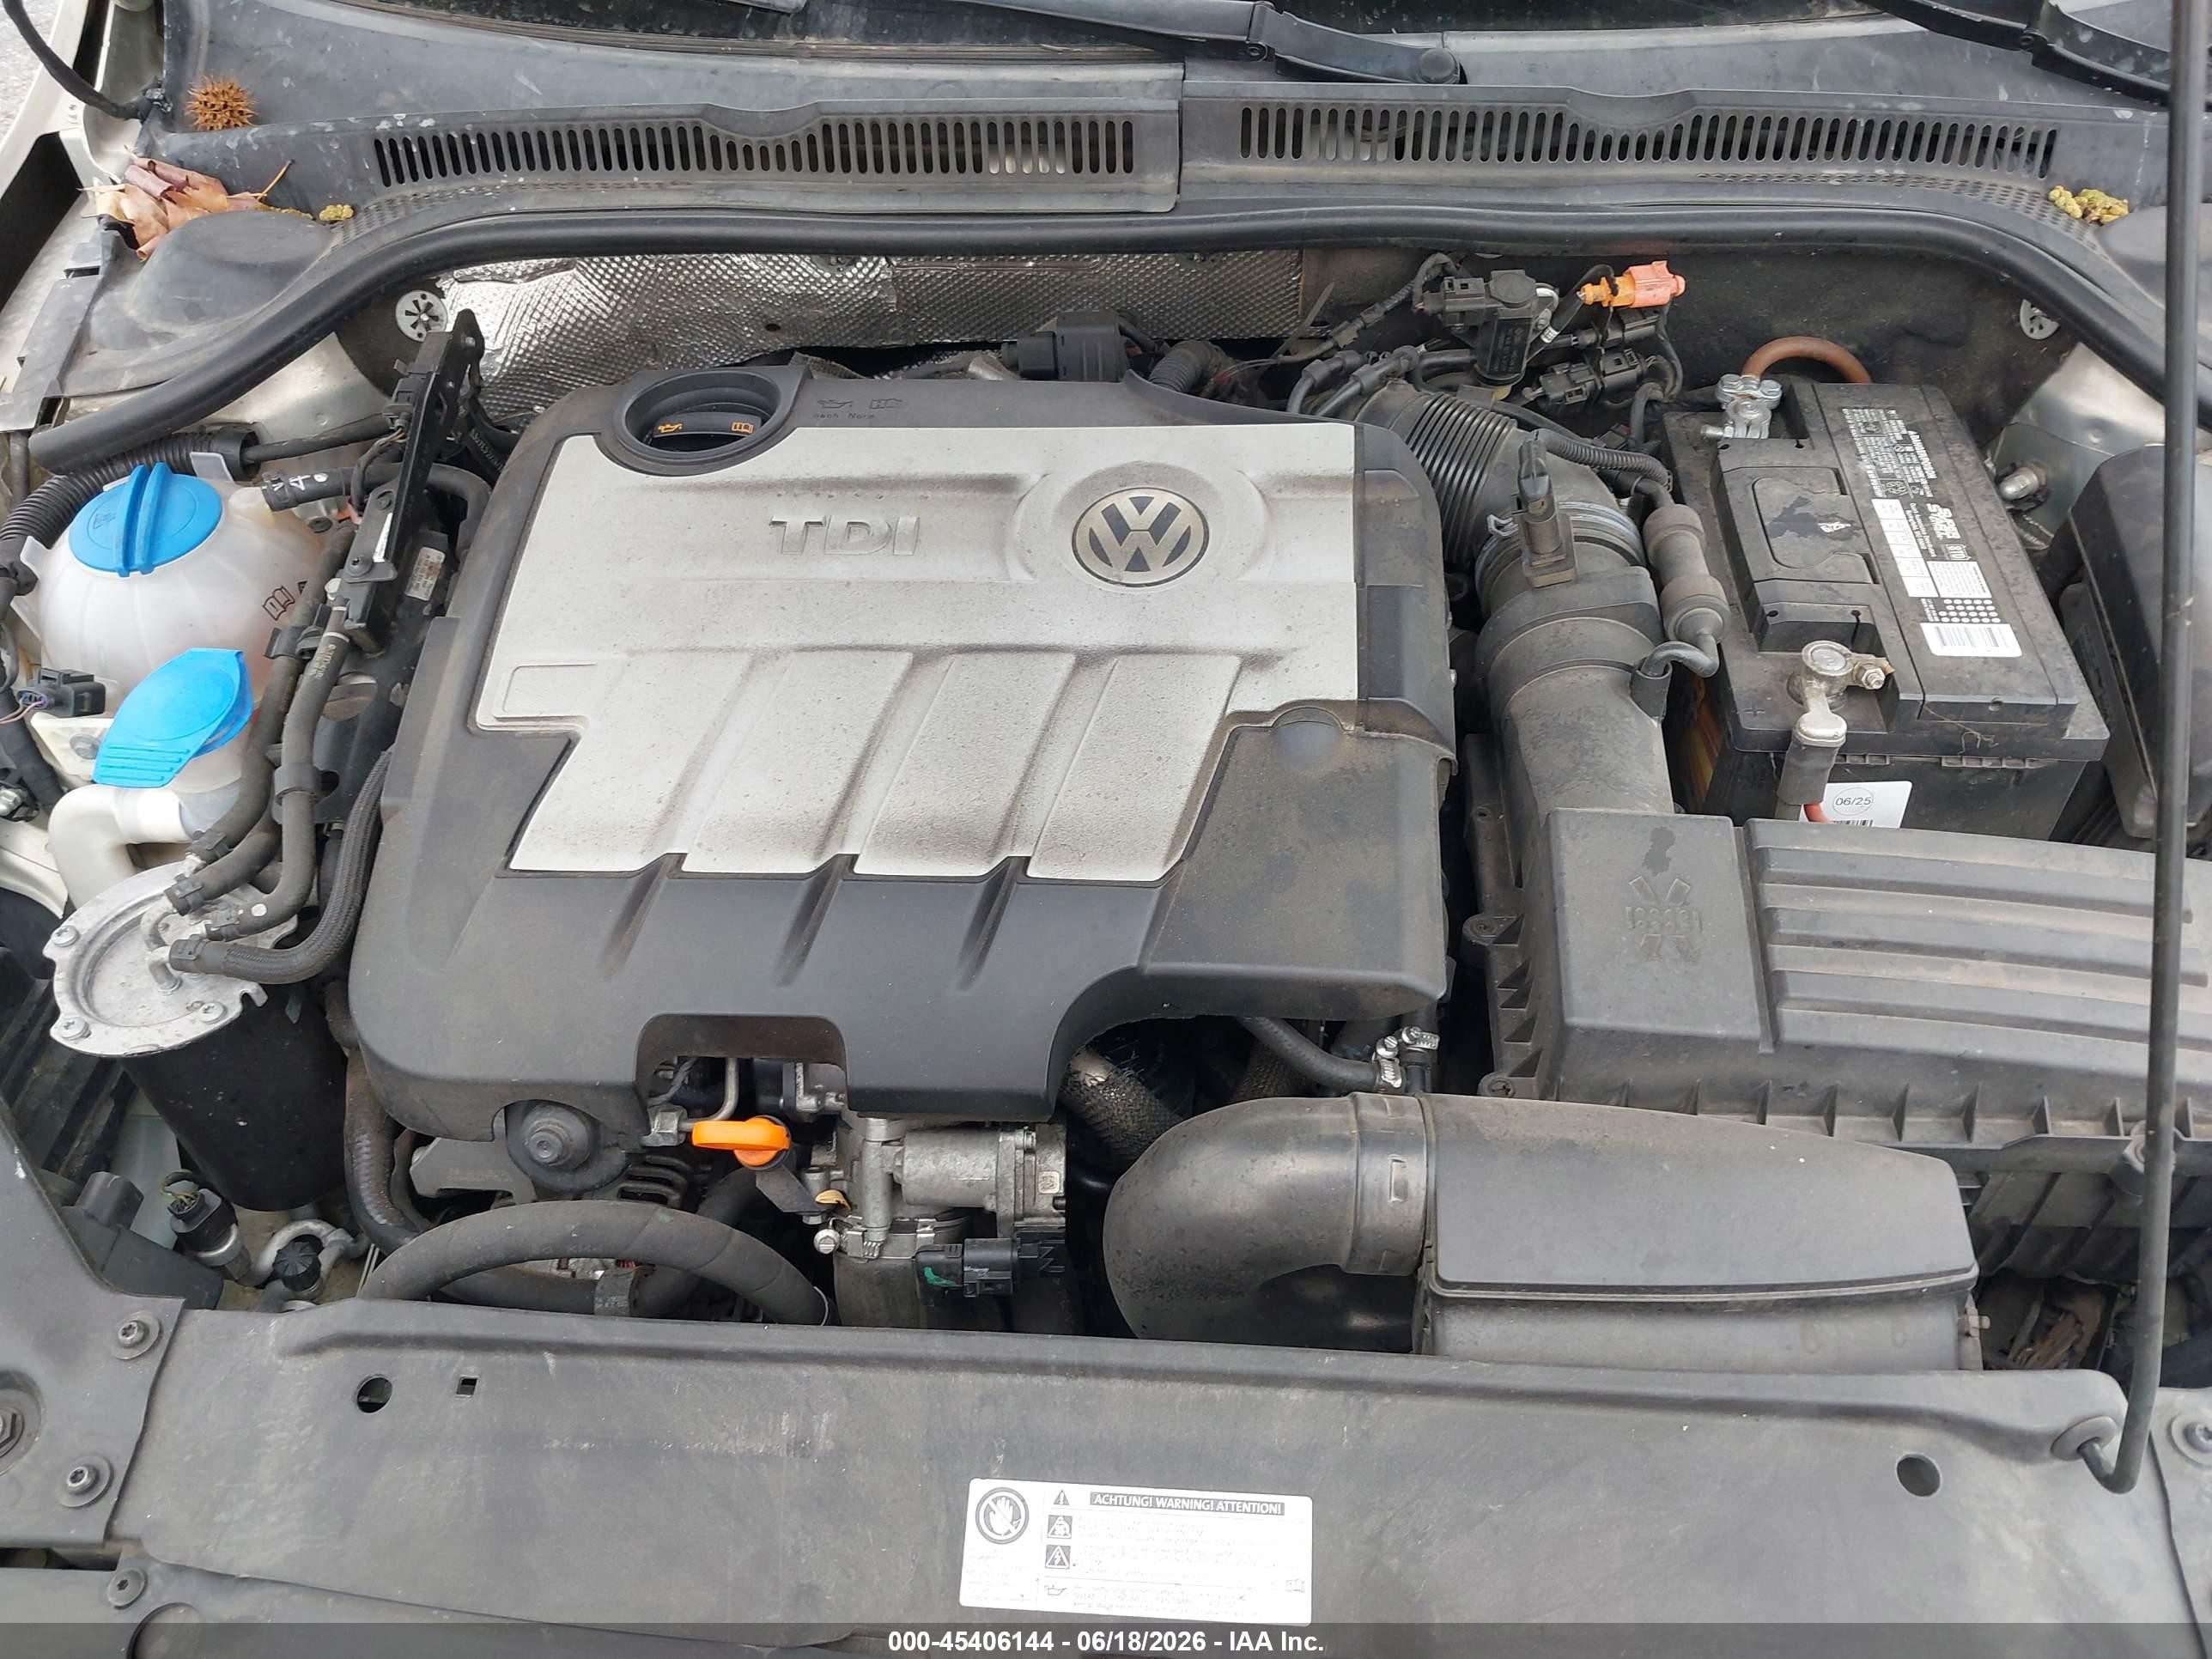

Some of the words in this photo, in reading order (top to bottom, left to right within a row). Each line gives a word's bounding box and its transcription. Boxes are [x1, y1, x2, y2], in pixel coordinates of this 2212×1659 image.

[769, 515, 920, 555] TDI
[1073, 489, 1206, 586] VW
[1936, 506, 1960, 539] SUPER
[1835, 797, 1872, 806] 06/25
[1093, 1493, 1153, 1508] ACHTUNG!
[1155, 1497, 1214, 1511] WARNING!
[1215, 1500, 1282, 1515] ATTENTION!
